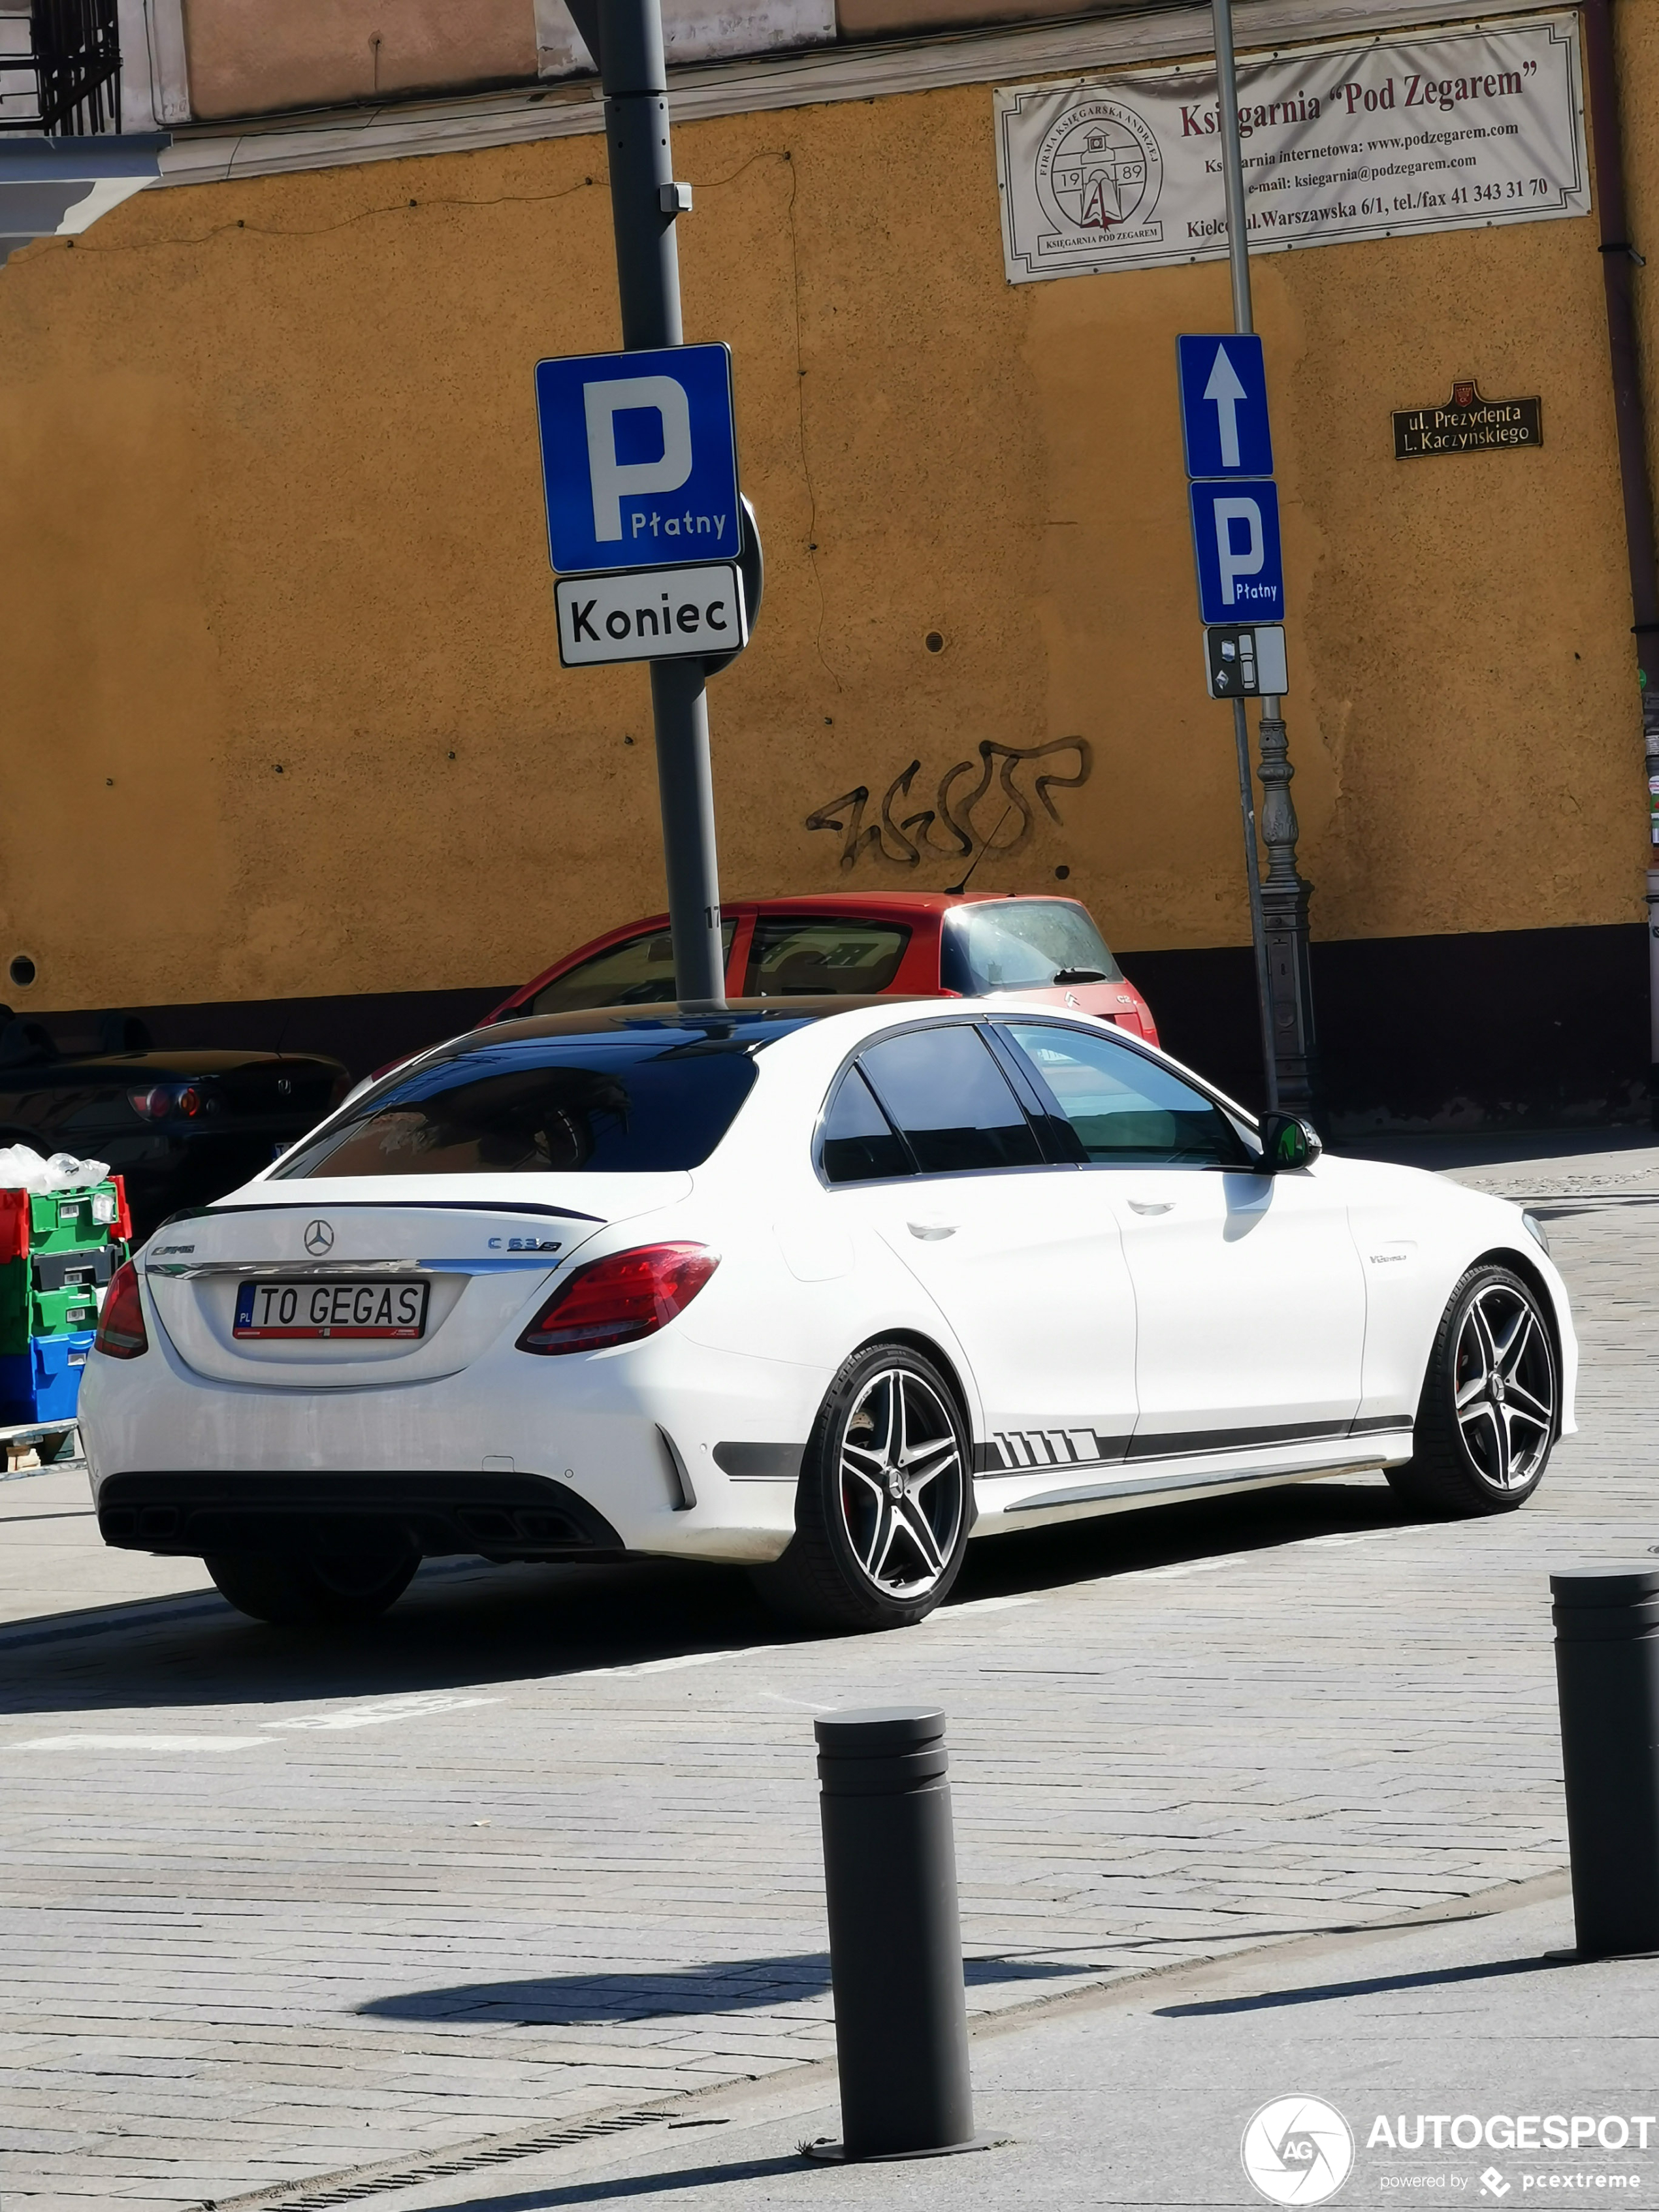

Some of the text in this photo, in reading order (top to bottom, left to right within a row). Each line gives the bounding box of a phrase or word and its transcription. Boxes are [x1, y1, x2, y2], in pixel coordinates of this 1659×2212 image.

[1179, 90, 1321, 138] Ksigarnia
[1040, 137, 1057, 176] FIRMA
[1125, 115, 1158, 163] ANDRZEJ
[1204, 124, 1519, 173] Ksarnia internetowa: www.podzegarem.com
[1061, 165, 1142, 187] 19 89
[1248, 156, 1477, 194] e-mail: ksiegarnia@podzegarem.com
[1361, 197, 1390, 216] 6/1,
[1393, 190, 1447, 212] tel./fax
[1451, 187, 1468, 204] 41
[1474, 182, 1502, 202] 343
[1506, 180, 1524, 199] 31
[1529, 178, 1548, 196] 70
[1046, 229, 1157, 249] KSIĘGARNIA POD ZEGAREM
[1409, 406, 1521, 430] ul. Prezydenta
[1404, 425, 1529, 451] L. Kaczyńskiego
[583, 375, 693, 543] P
[631, 510, 726, 540] Płatny
[1213, 497, 1264, 605] P
[1236, 583, 1277, 601] Płatny
[571, 593, 728, 643] Koniec
[240, 1313, 250, 1323] PL
[310, 1287, 419, 1324] GEGAS
